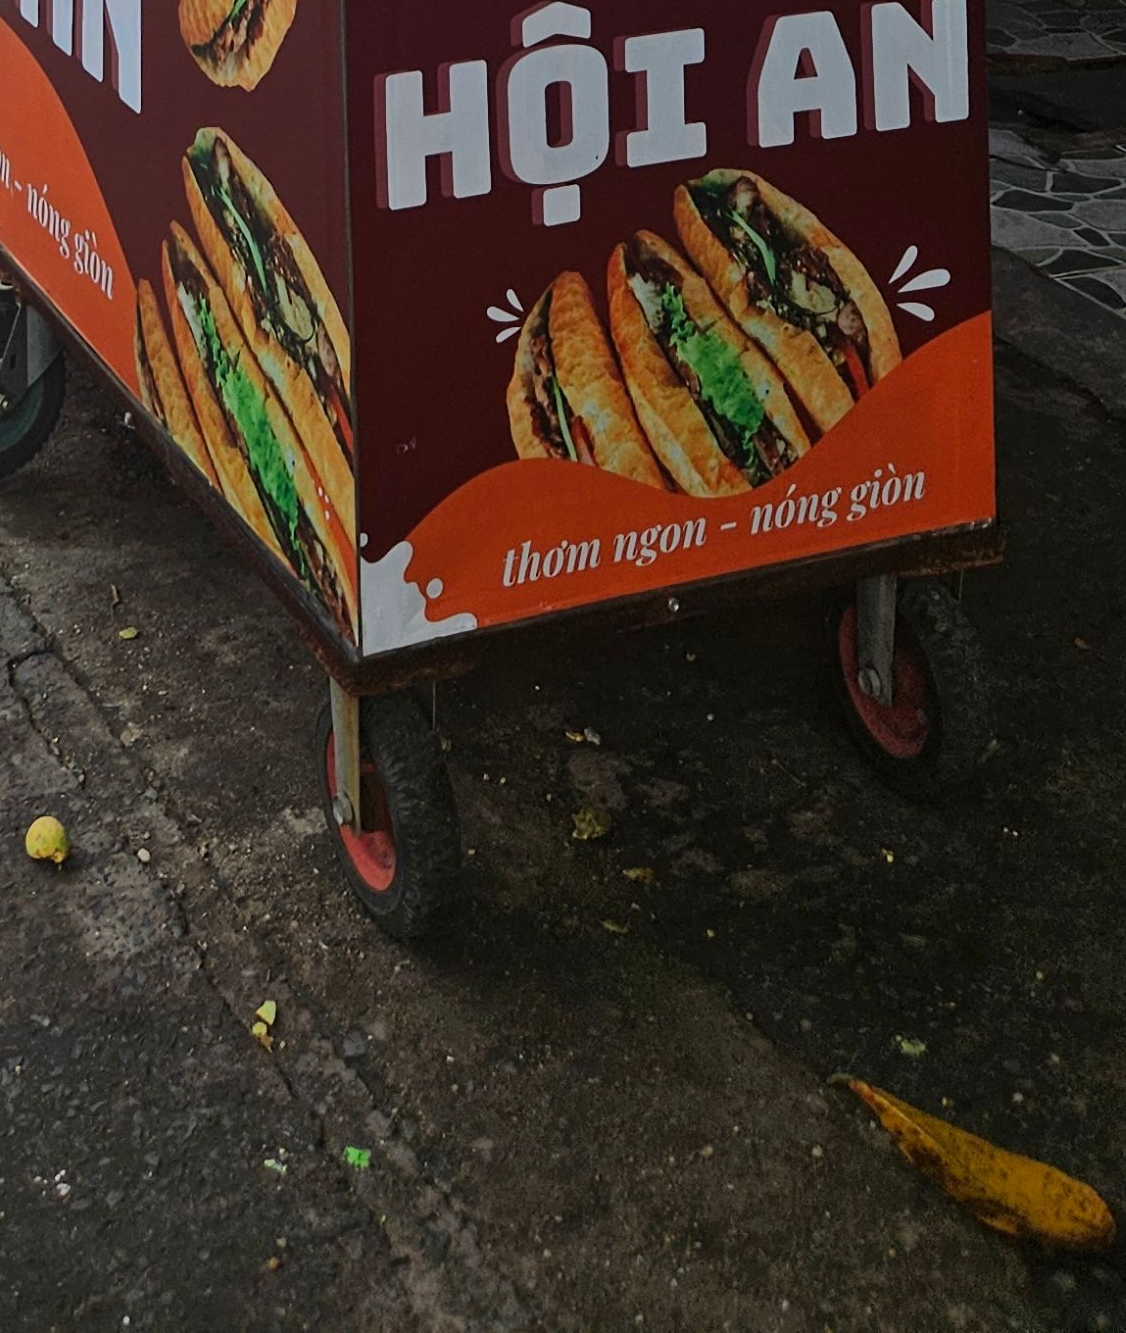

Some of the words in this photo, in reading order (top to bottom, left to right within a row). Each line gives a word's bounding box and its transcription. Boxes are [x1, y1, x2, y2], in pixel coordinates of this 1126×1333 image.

[381, 0, 708, 227] HỘI
[27, 183, 71, 260] nóng
[73, 230, 113, 300] giòn
[502, 539, 602, 588] thơm
[612, 516, 707, 567] ngon
[750, 483, 843, 534] nóng
[850, 462, 926, 520] giòn
